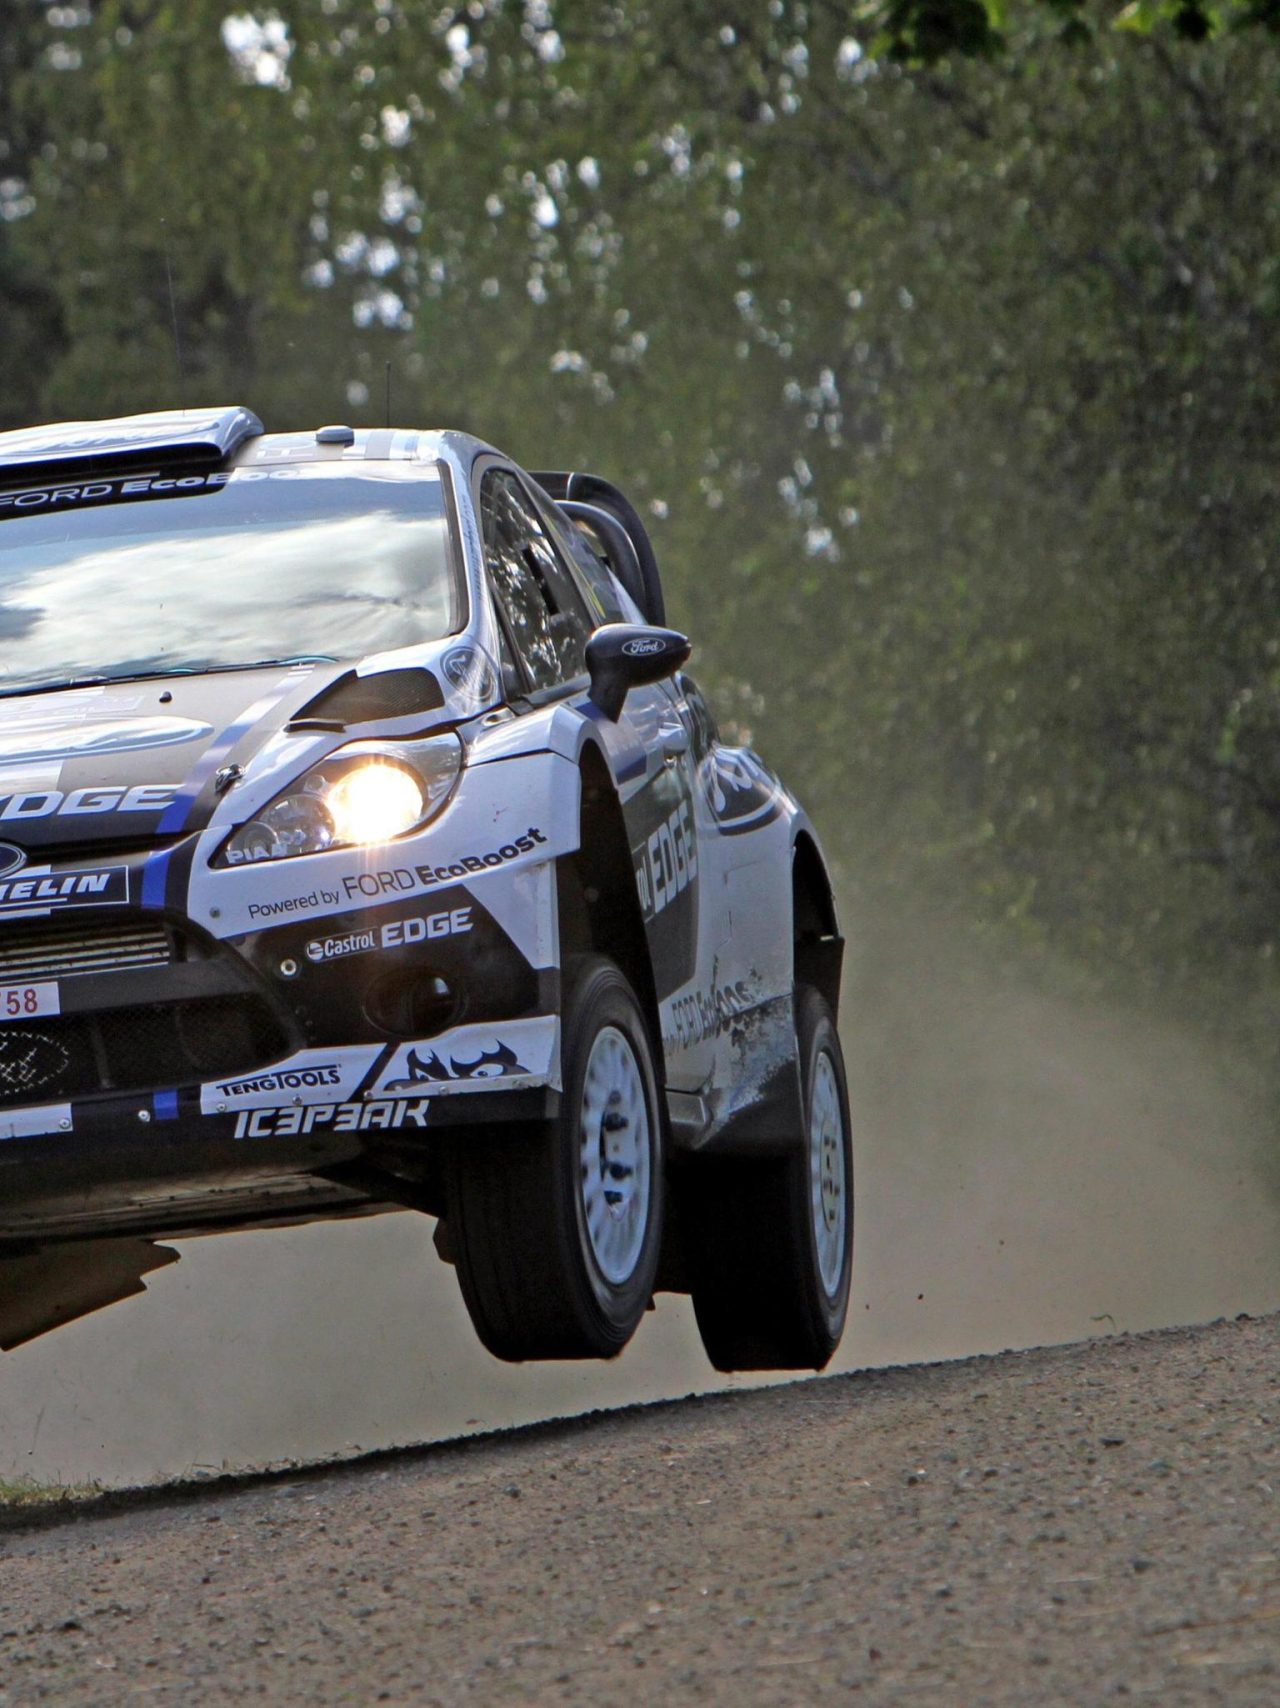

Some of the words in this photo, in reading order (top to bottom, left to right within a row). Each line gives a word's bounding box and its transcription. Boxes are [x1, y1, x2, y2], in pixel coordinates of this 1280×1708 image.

[630, 639, 659, 654] Ford
[248, 892, 318, 919] Powered
[320, 889, 340, 905] by
[342, 869, 416, 899] FORD
[416, 827, 548, 885] EcoBoost
[648, 799, 698, 914] EDGE
[324, 935, 375, 958] Castrol
[381, 907, 474, 948] EDGE
